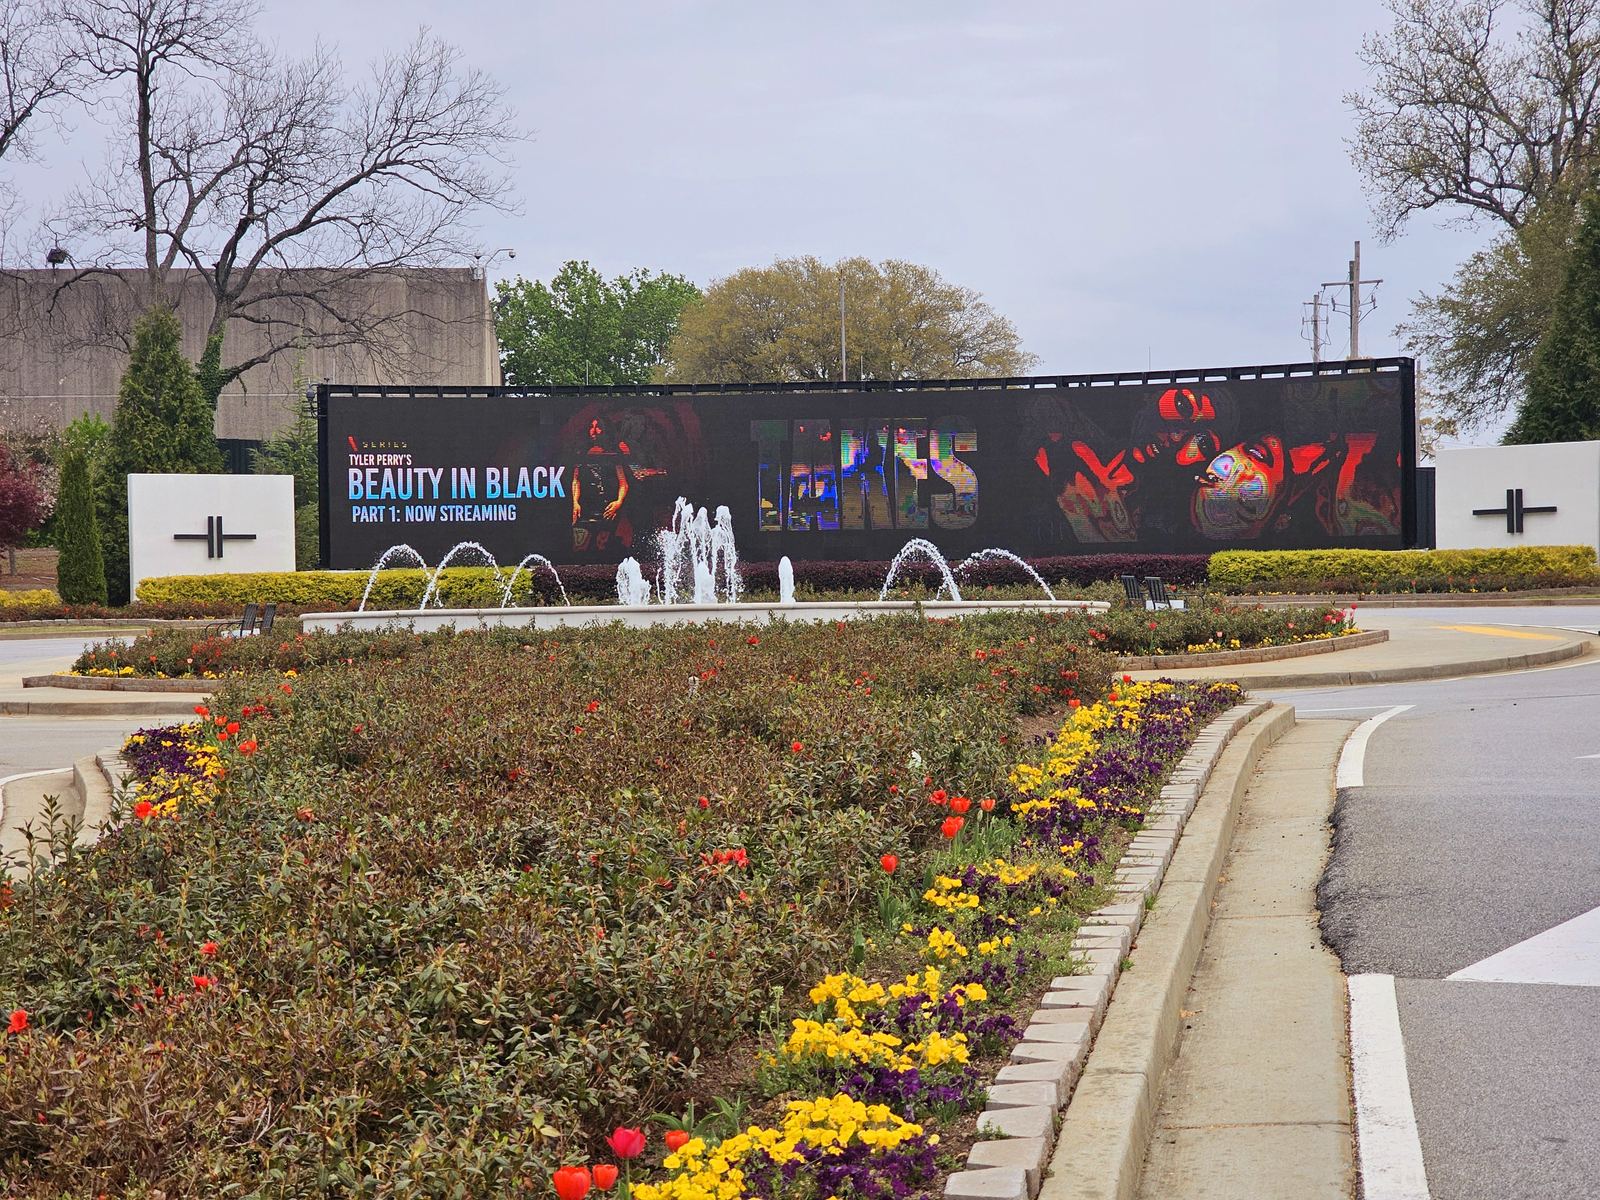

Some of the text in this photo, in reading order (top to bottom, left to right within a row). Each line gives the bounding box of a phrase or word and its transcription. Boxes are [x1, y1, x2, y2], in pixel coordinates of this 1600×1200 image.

[348, 453, 412, 466] TYLER PERRY'S
[348, 466, 566, 500] BEAUTY IN BLACK
[352, 504, 517, 523] PART 1: NOW STREAMING
